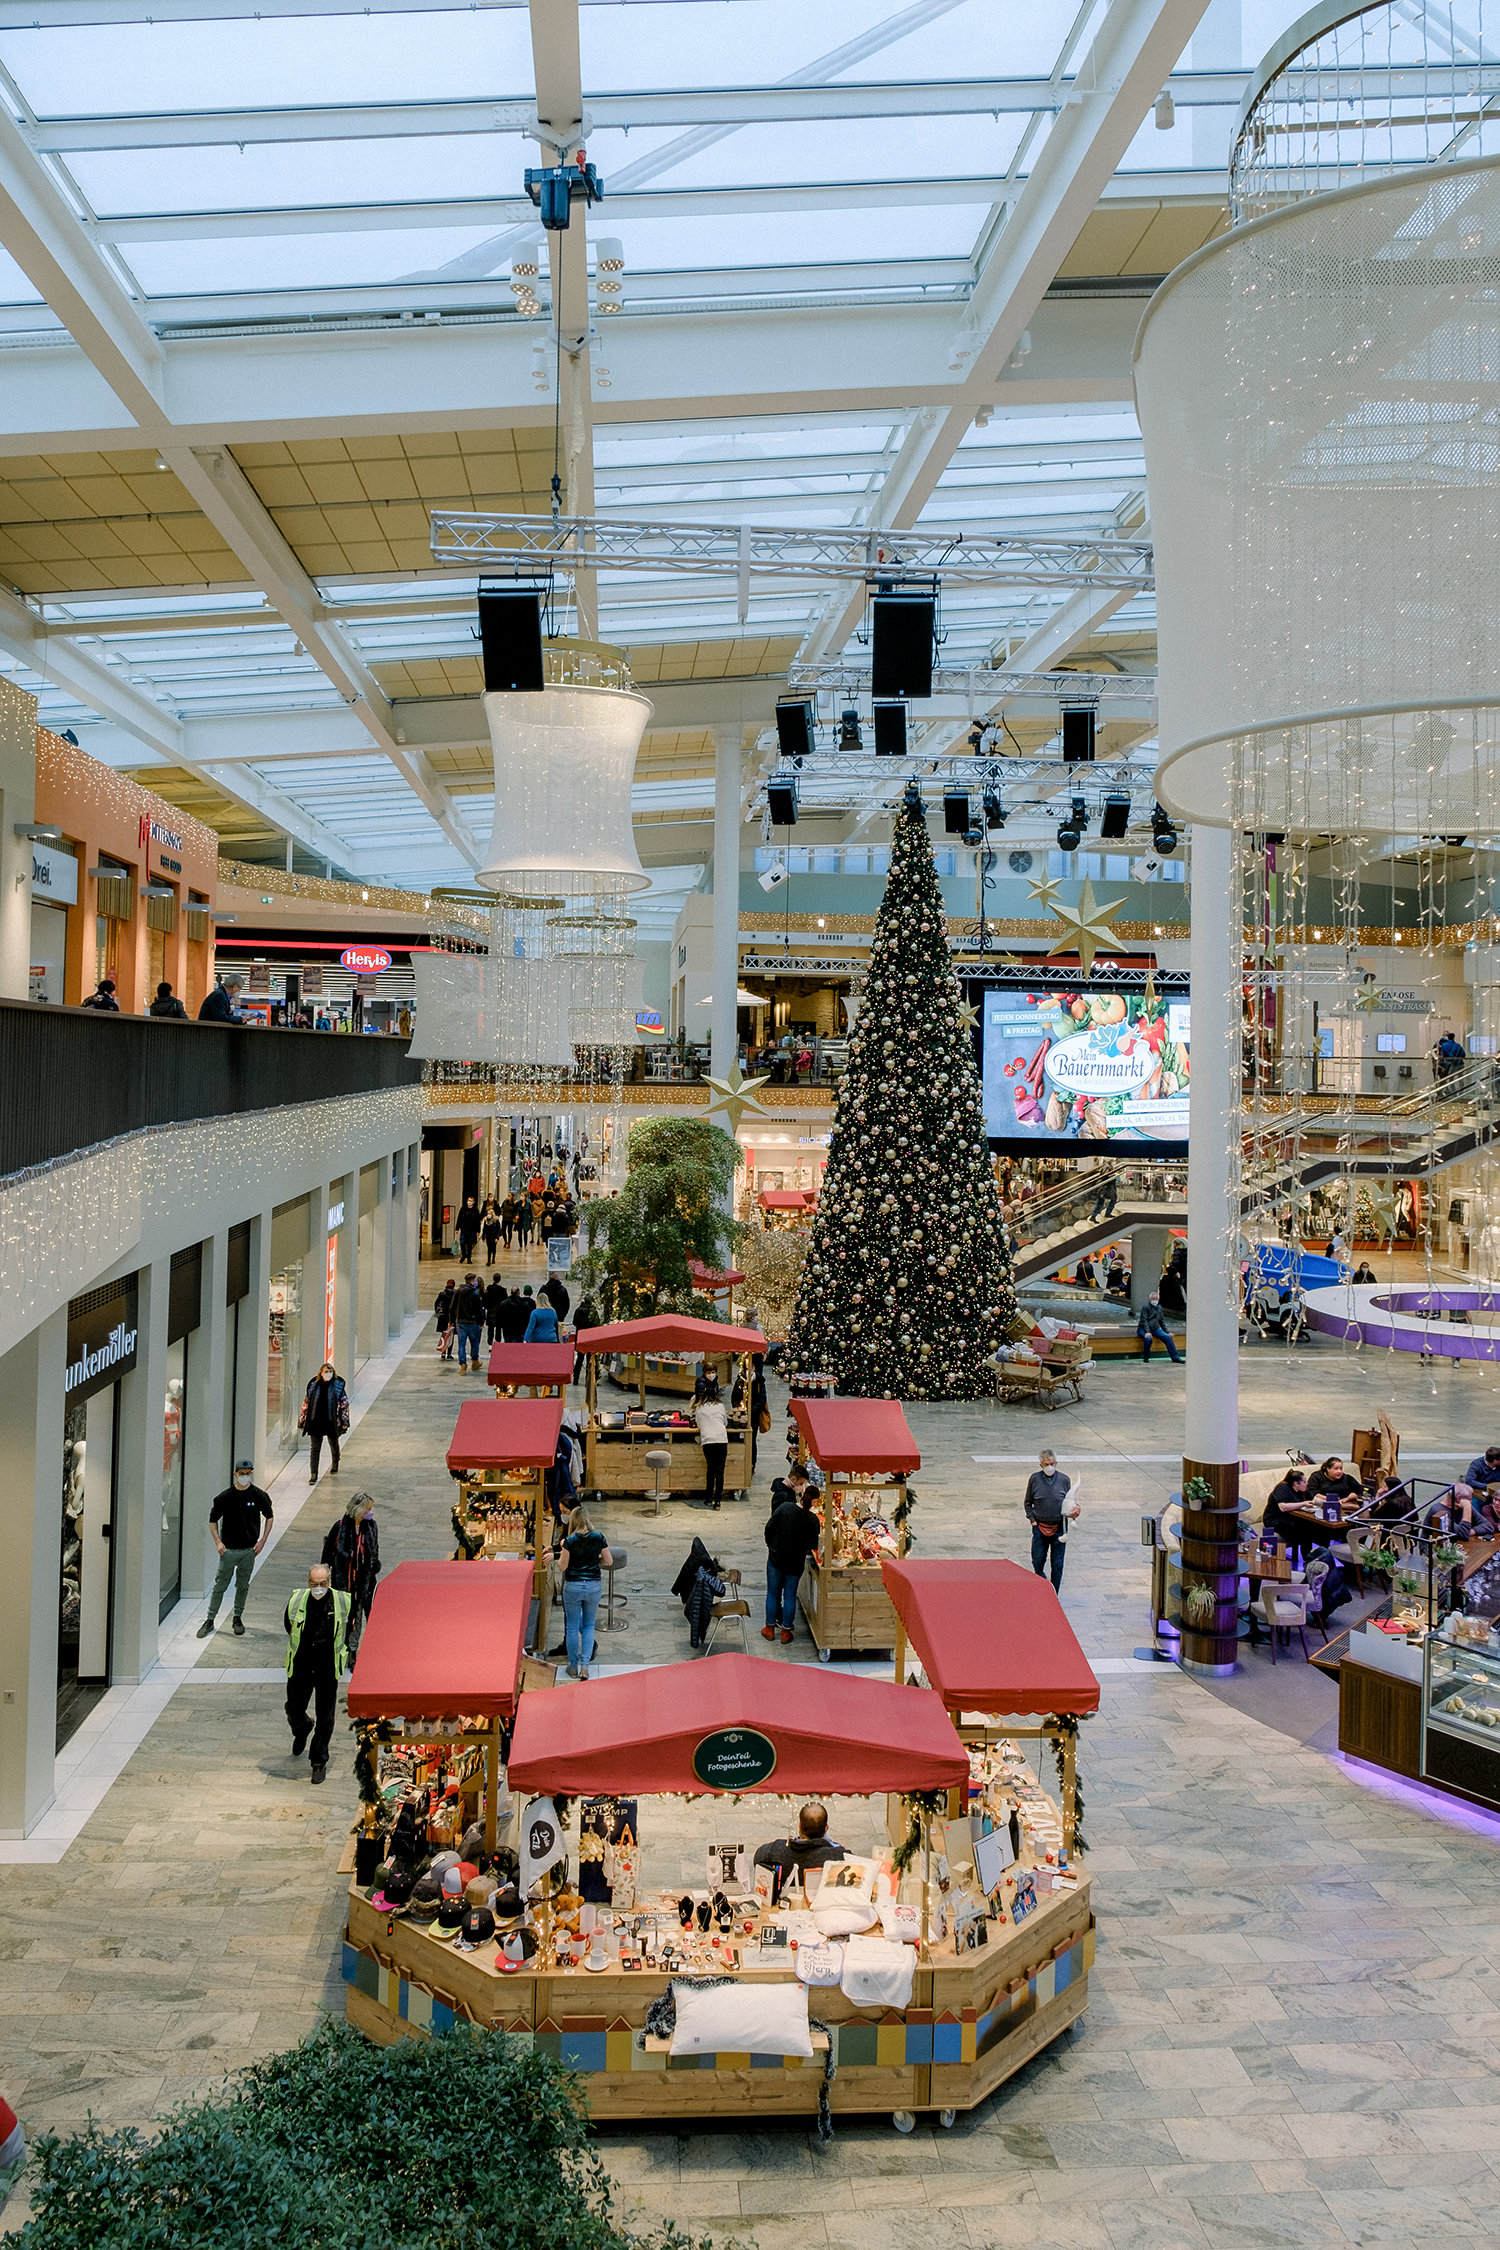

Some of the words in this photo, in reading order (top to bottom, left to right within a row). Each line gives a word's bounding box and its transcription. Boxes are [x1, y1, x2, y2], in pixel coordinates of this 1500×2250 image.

[346, 951, 388, 968] Hervis
[993, 1012, 1014, 1022] JEDEN
[1014, 1012, 1060, 1021] DONNERSTAG
[1012, 1026, 1041, 1035] FREITAG
[1071, 1048, 1097, 1062] Mein
[1053, 1054, 1145, 1078] Bauernmarkt
[707, 1760, 762, 1772] Fotogeschenke
